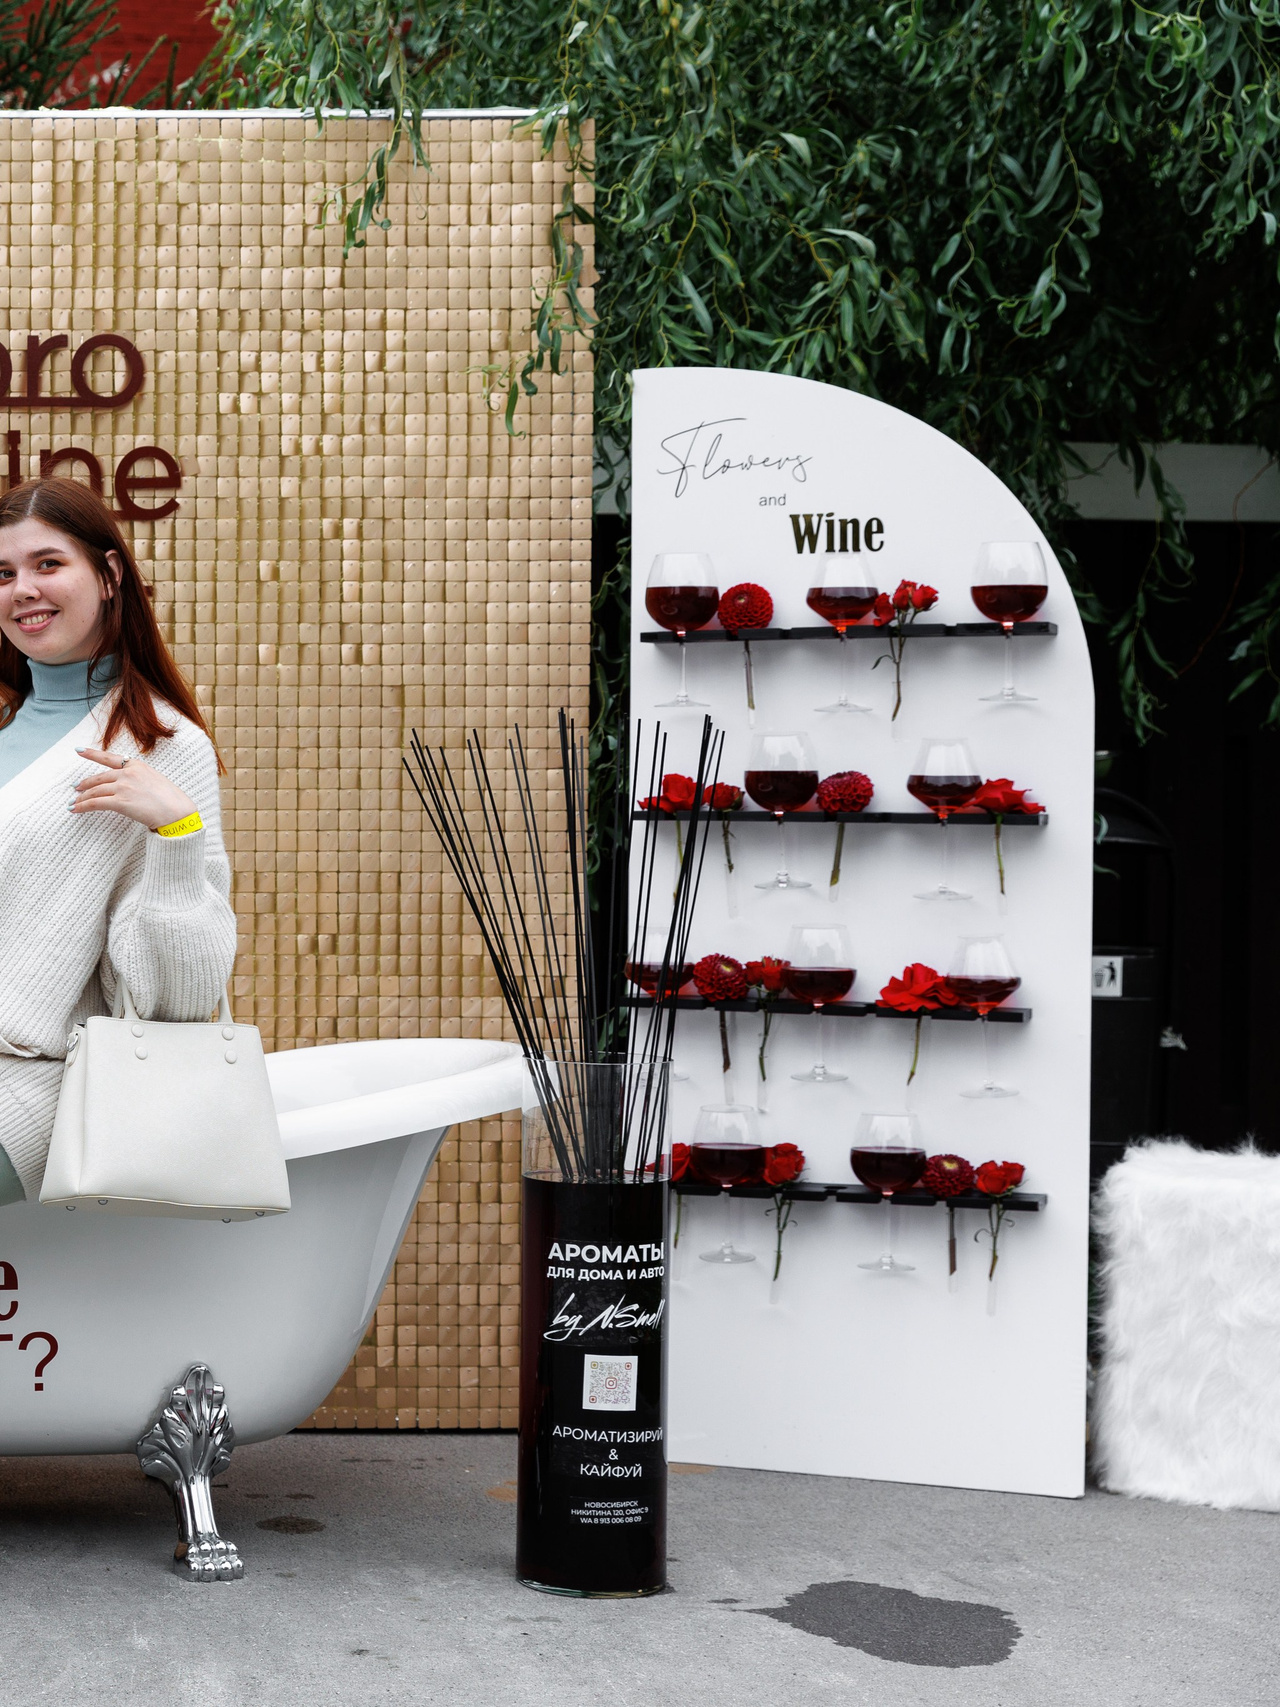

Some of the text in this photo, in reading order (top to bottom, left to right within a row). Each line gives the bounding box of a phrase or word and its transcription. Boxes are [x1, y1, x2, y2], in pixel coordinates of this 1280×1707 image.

[657, 417, 813, 498] Flowers
[758, 493, 787, 506] and
[789, 512, 885, 554] Wine
[548, 1242, 664, 1263] АРОМАТЫ
[546, 1266, 665, 1281] ДЛЯ ДОМА И АВТО
[543, 1292, 583, 1342] by
[552, 1425, 663, 1443] АРОМАТИЗИРУЙ
[608, 1448, 619, 1461] &
[580, 1462, 643, 1478] КАЙФУЙ
[570, 1508, 612, 1516] НИКИТИНА
[625, 1508, 645, 1516] ОФИС
[584, 1500, 639, 1508] НОВОСИБИРСК
